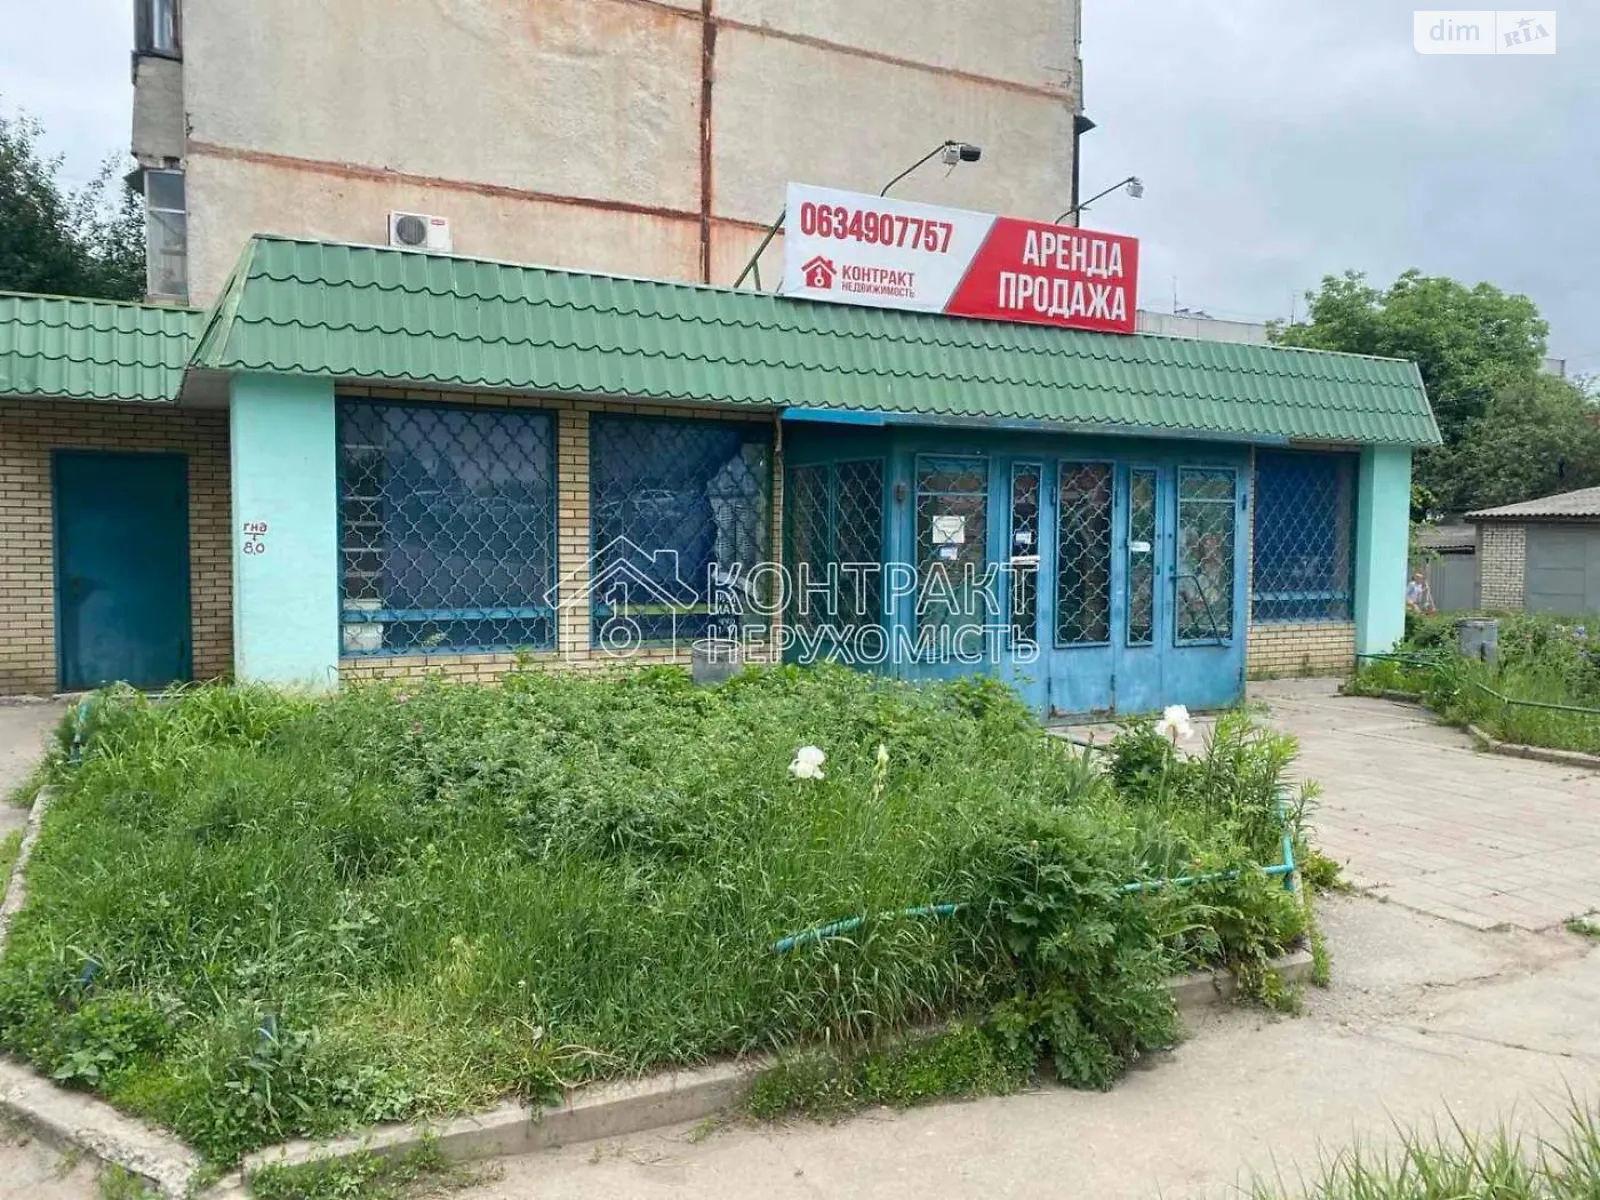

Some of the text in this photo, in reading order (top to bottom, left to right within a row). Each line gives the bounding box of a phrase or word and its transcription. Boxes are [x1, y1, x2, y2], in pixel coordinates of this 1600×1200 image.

[800, 201, 953, 253] 0634907757
[842, 264, 915, 288] КОНТРАКТ
[1022, 229, 1123, 279] АРЕНДА
[842, 281, 915, 298] НЕДВИЖИМОСТЬ
[999, 271, 1126, 321] ПРОДАЖА
